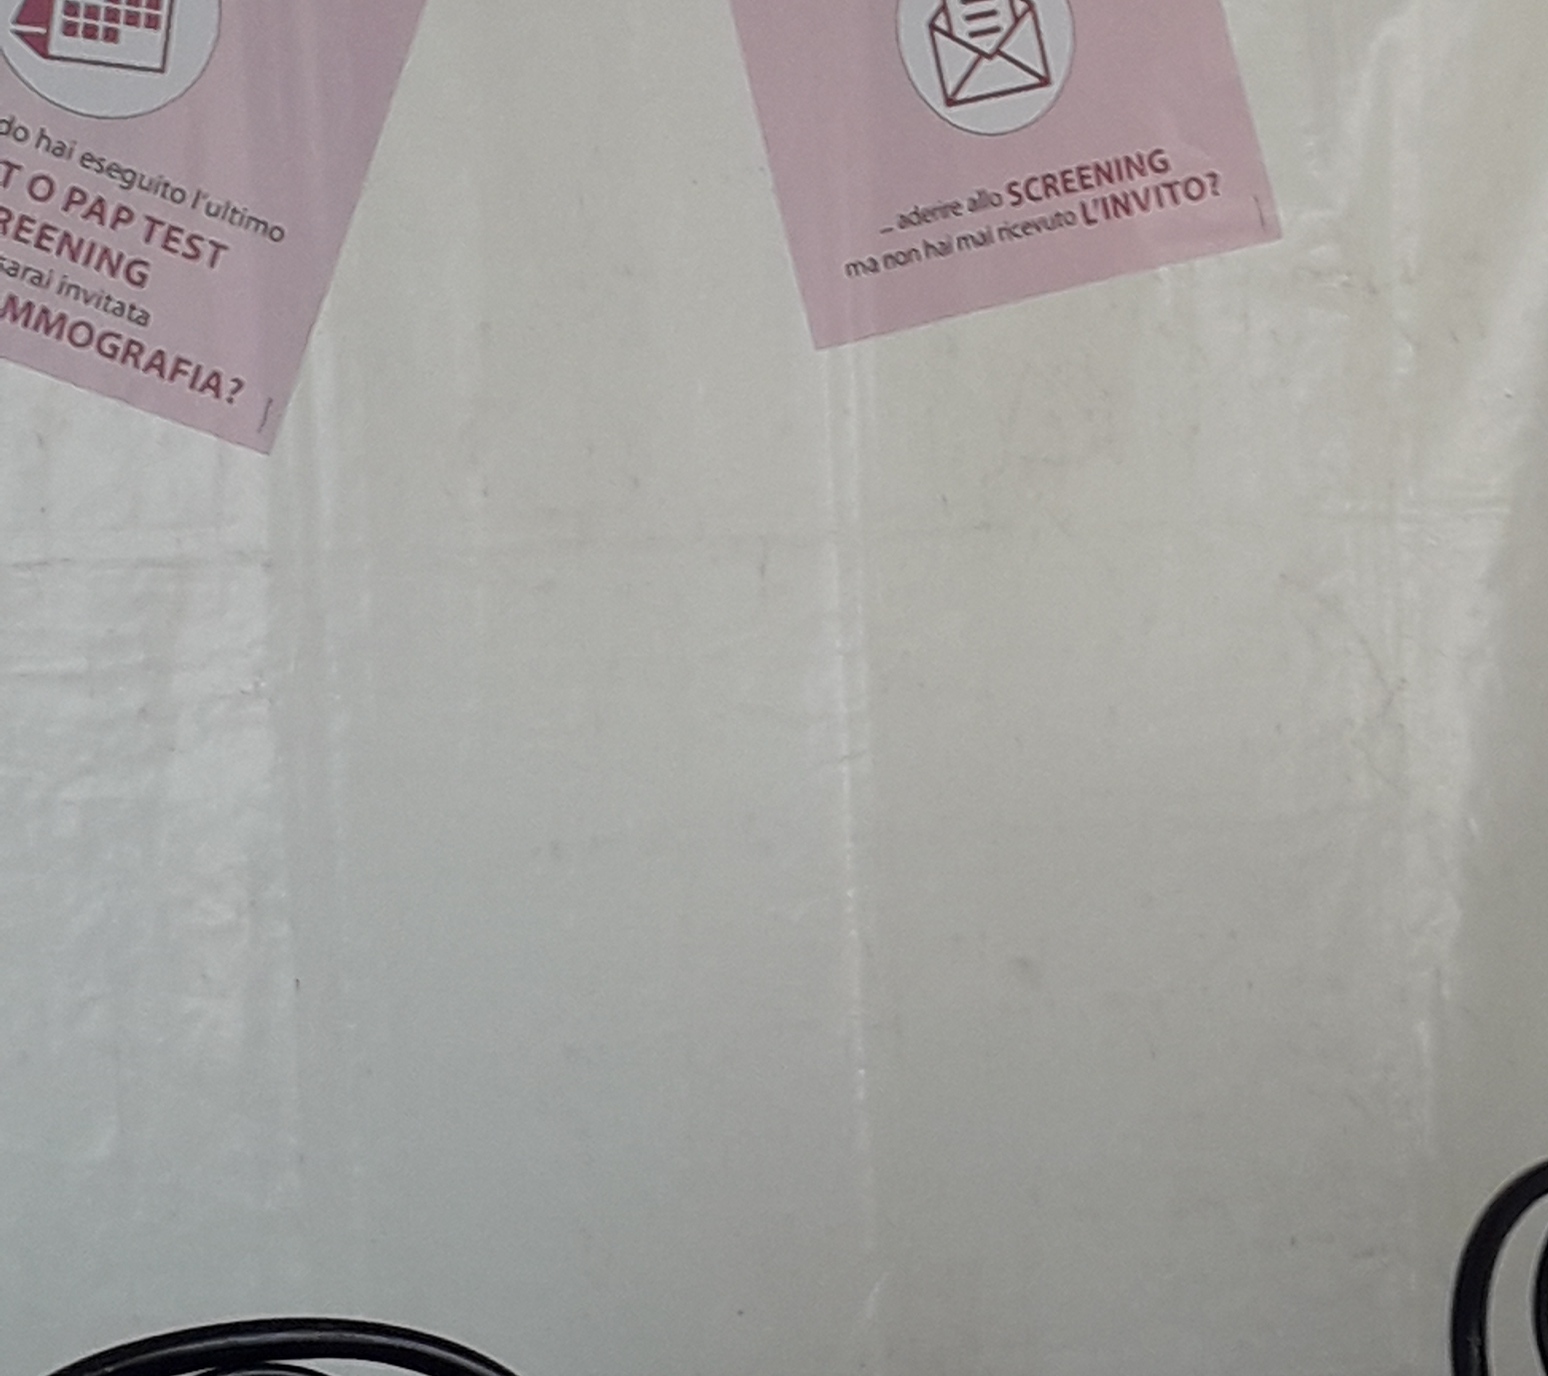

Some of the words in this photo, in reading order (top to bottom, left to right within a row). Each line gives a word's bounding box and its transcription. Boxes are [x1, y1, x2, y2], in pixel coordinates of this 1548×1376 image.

[27, 175, 55, 203] O
[61, 186, 135, 231] PAP
[145, 215, 229, 269] TEST
[34, 127, 76, 160] hai
[79, 150, 187, 205] eseguito
[191, 188, 286, 243] l'ultimo
[845, 255, 880, 277] ma
[882, 246, 922, 270] non
[923, 237, 955, 261] hai
[956, 227, 996, 251] mai
[996, 211, 1078, 241] ricevuto
[1079, 171, 1222, 227] L'INVITO?
[1006, 148, 1171, 207] SCREENING
[56, 275, 151, 327] invitata
